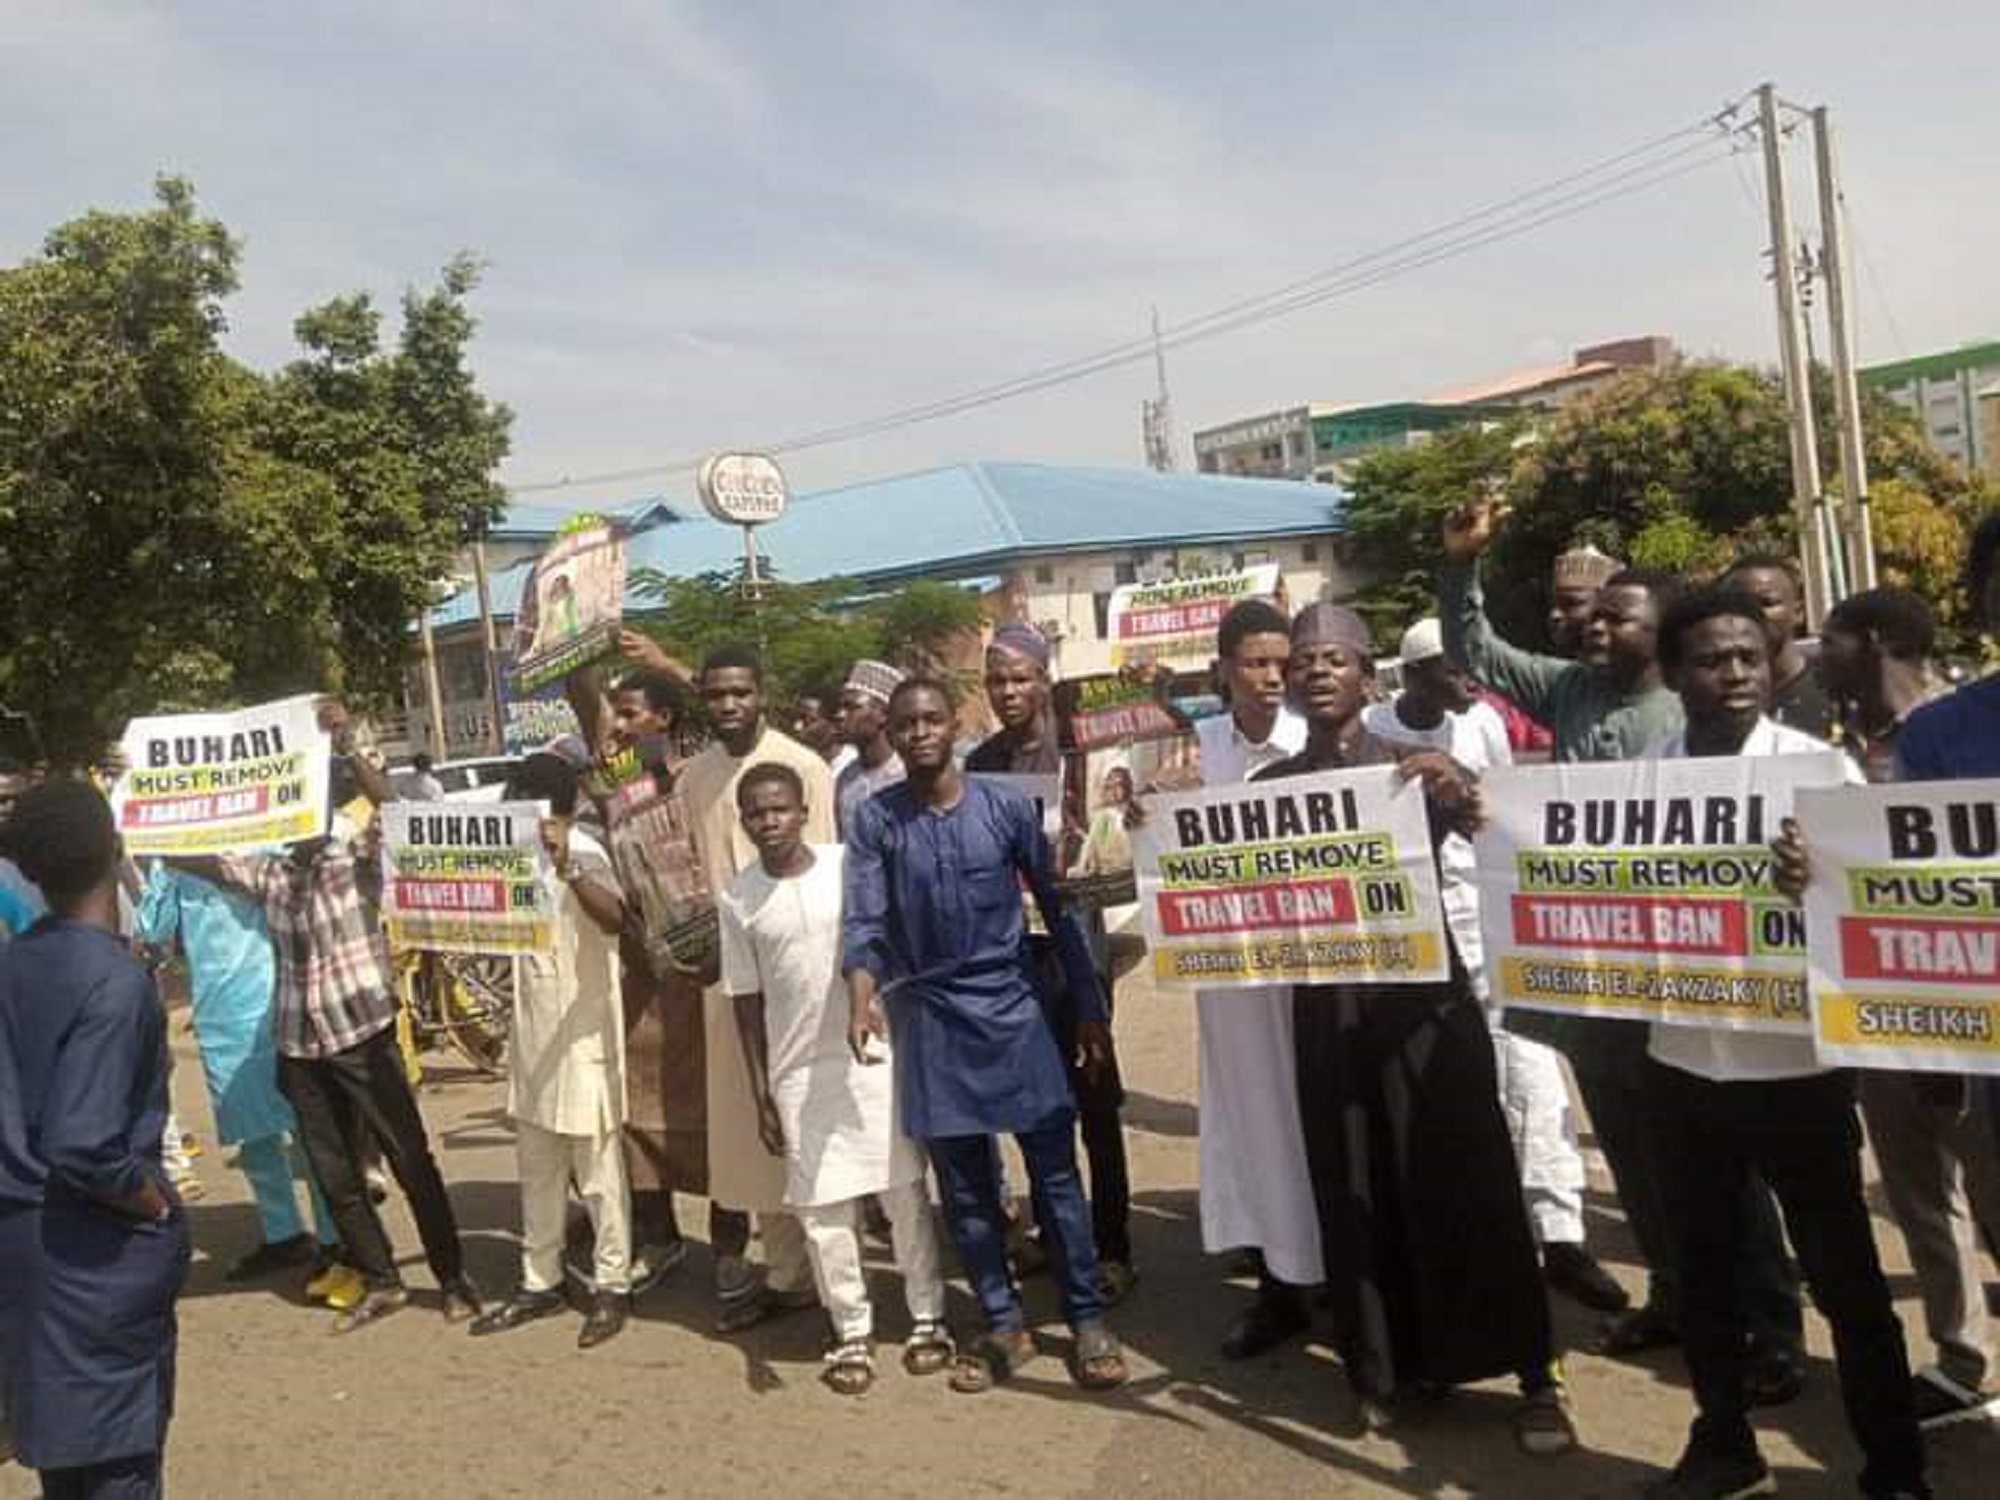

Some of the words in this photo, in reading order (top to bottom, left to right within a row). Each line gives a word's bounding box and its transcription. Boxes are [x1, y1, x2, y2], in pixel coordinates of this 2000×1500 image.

[1132, 608, 1184, 633] TRAVEL
[148, 725, 284, 767] BUHARI
[135, 773, 204, 794] MUST
[210, 758, 296, 788] REMOVE
[277, 782, 301, 804] ON
[408, 816, 513, 846] BUHARI
[1175, 789, 1360, 848] BUHARI
[1545, 796, 1766, 845] BUHARI
[1166, 855, 1245, 882] MUST
[1255, 841, 1384, 876] REMOVE
[1527, 859, 1620, 887] MUST
[1631, 860, 1777, 887] REMOV
[1179, 890, 1273, 929] TRAVEL
[1277, 886, 1334, 922] BAN
[1366, 881, 1406, 914] ON
[1863, 876, 2000, 907] MUST
[1529, 903, 1645, 942] TRAVEL
[1654, 907, 1724, 946] BAN
[1762, 909, 1806, 948] ON
[1524, 965, 1605, 994] SHEIKH
[1857, 1000, 1992, 1040] SHEIKH
